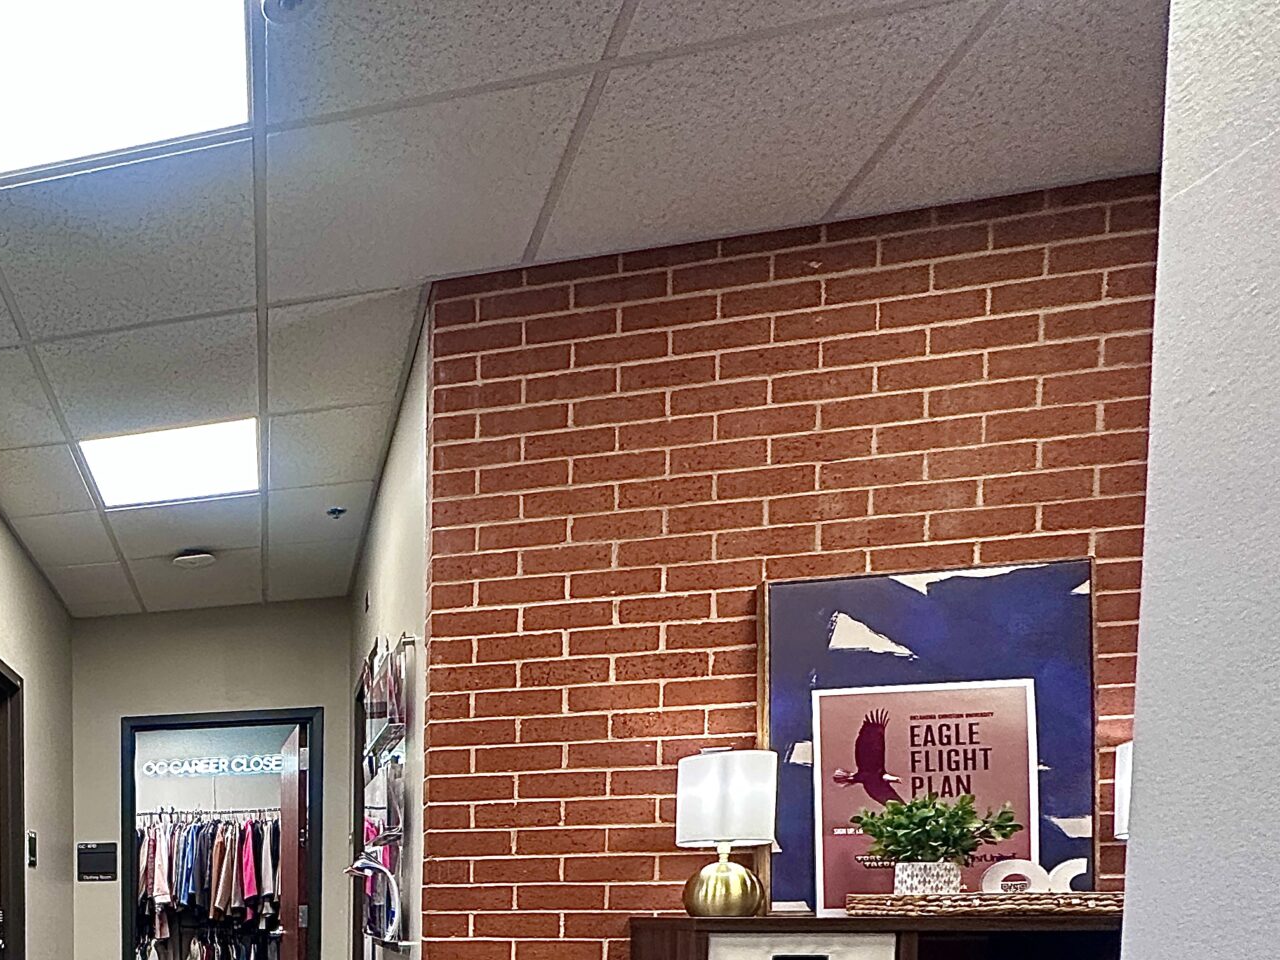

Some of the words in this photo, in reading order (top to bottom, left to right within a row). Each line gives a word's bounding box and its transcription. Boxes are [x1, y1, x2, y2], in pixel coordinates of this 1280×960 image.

[909, 722, 981, 747] EAGLE
[169, 757, 229, 775] CAREER
[910, 748, 993, 773] FLIGHT
[911, 774, 972, 799] PLAN
